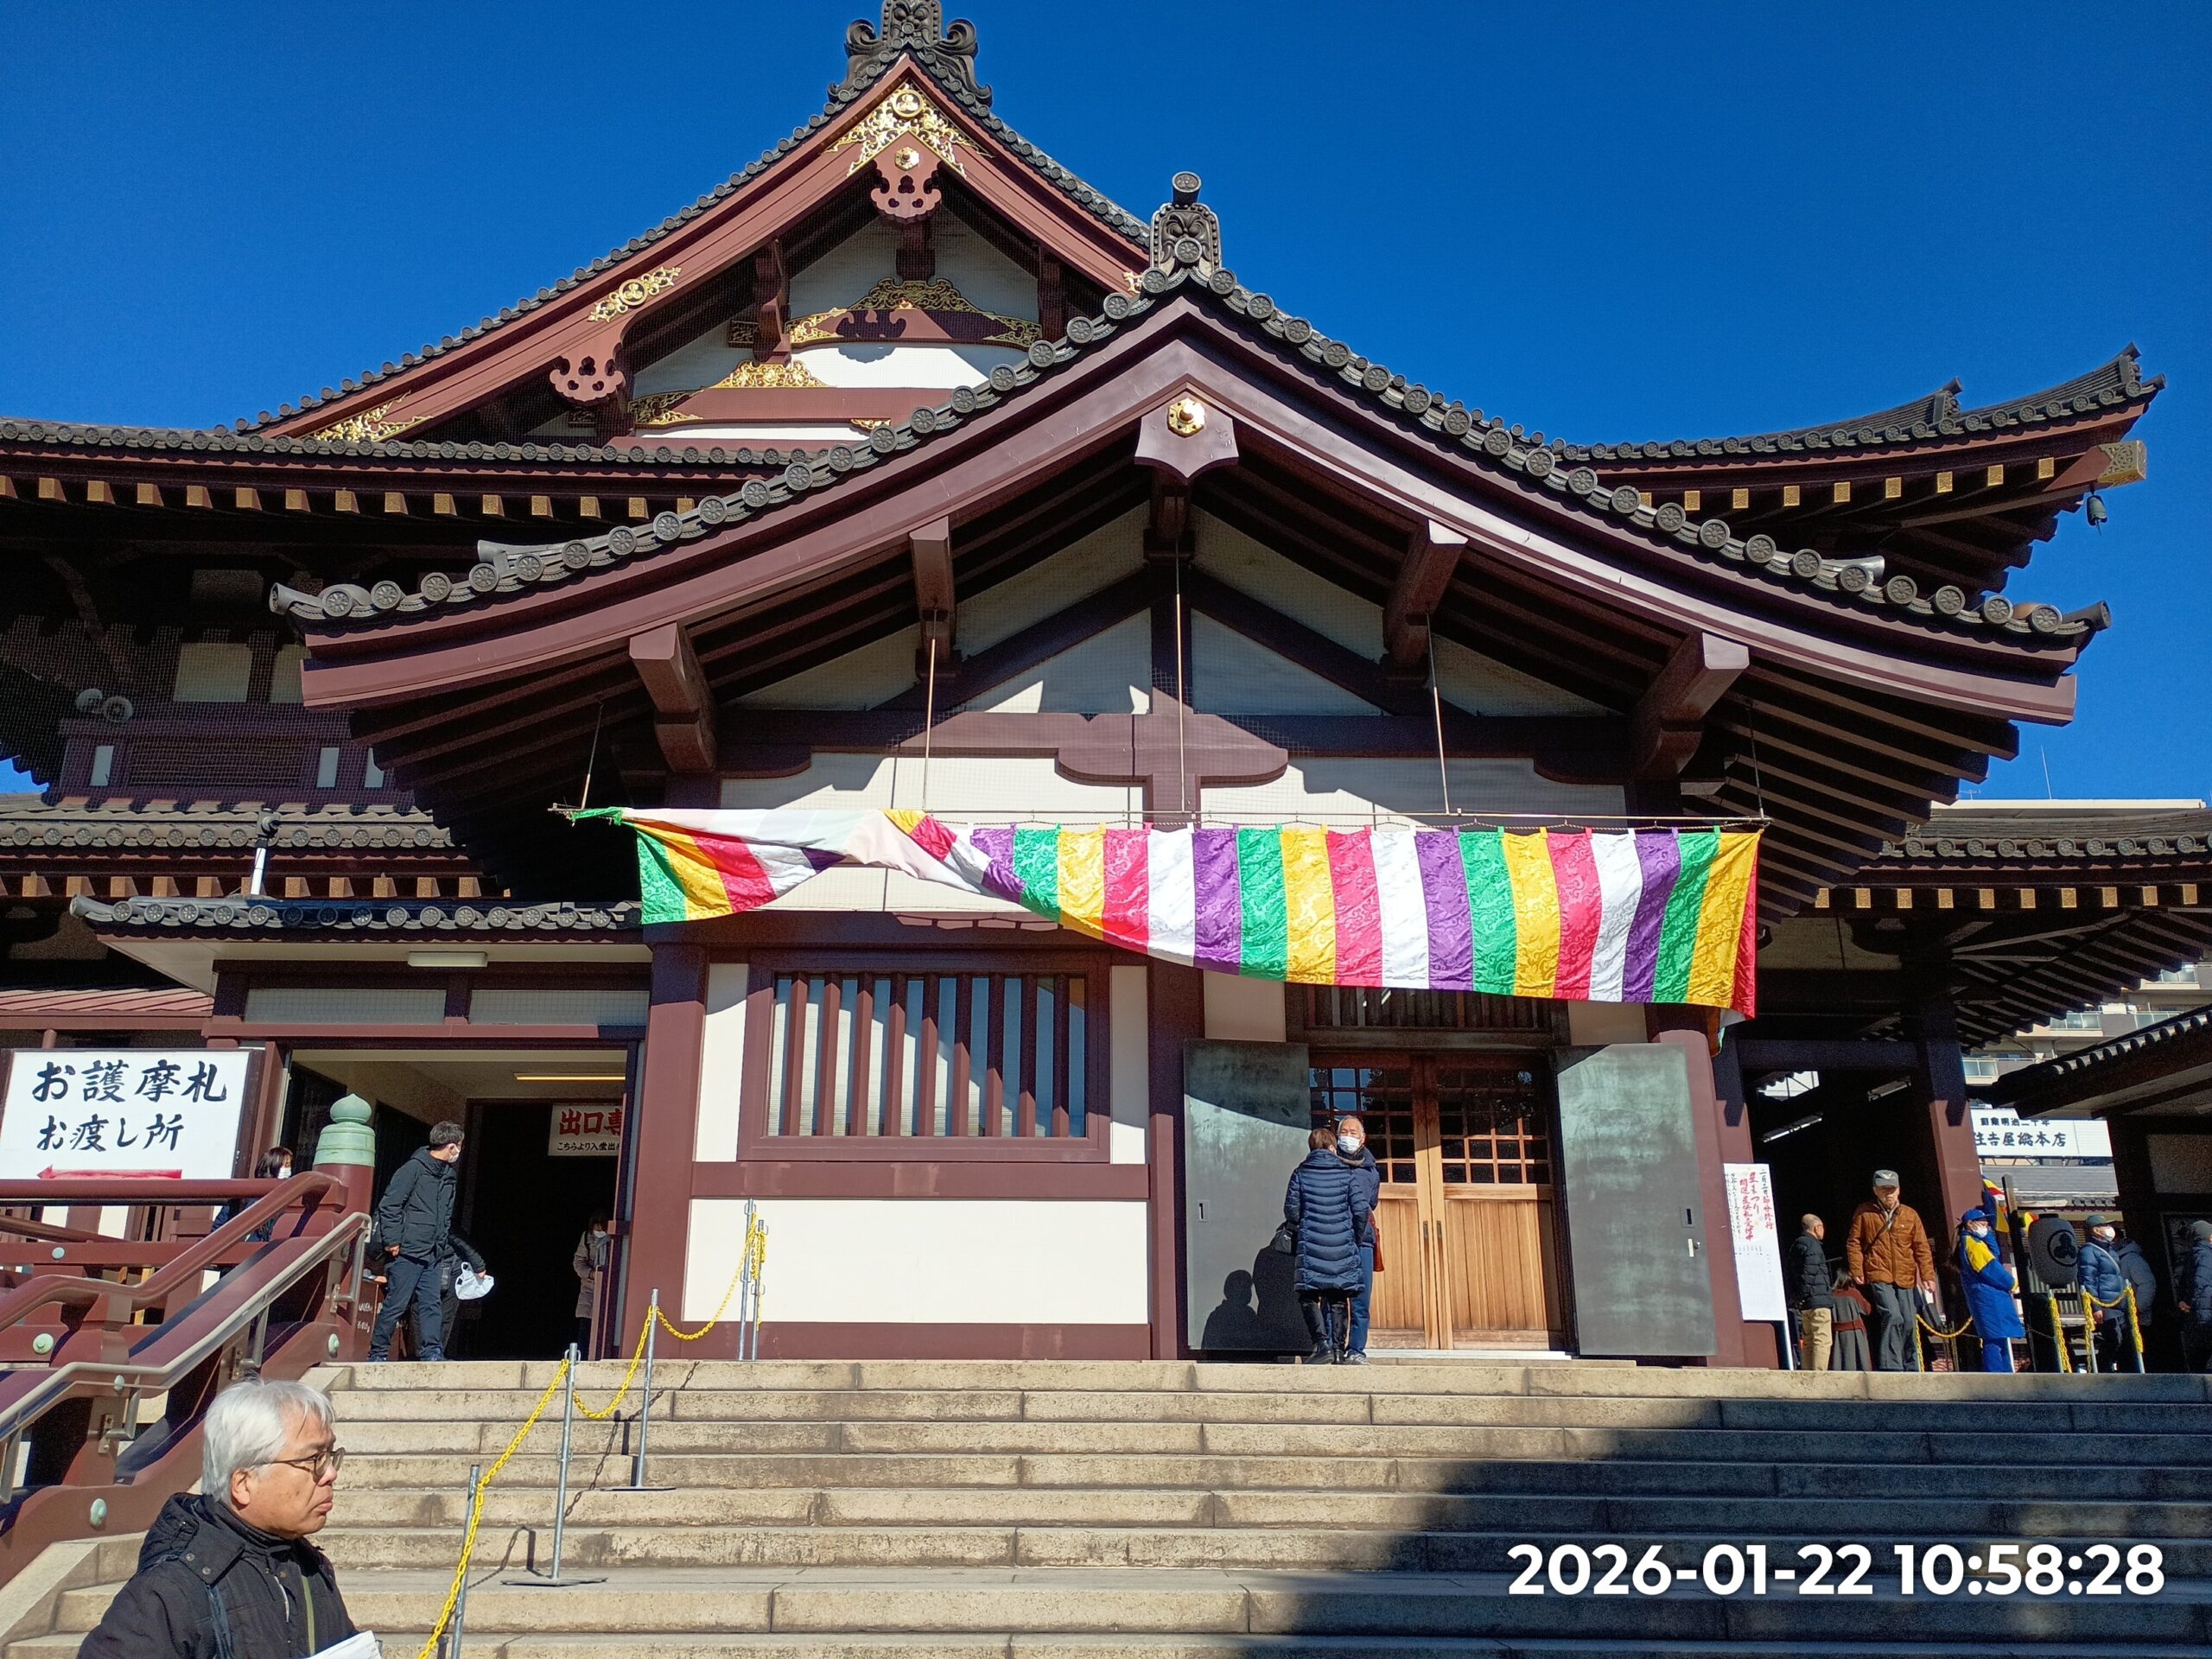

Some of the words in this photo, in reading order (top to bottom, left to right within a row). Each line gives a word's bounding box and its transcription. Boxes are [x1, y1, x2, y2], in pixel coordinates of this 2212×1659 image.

[32, 1059, 227, 1103] お護摩札
[36, 1113, 184, 1152] お渡し所
